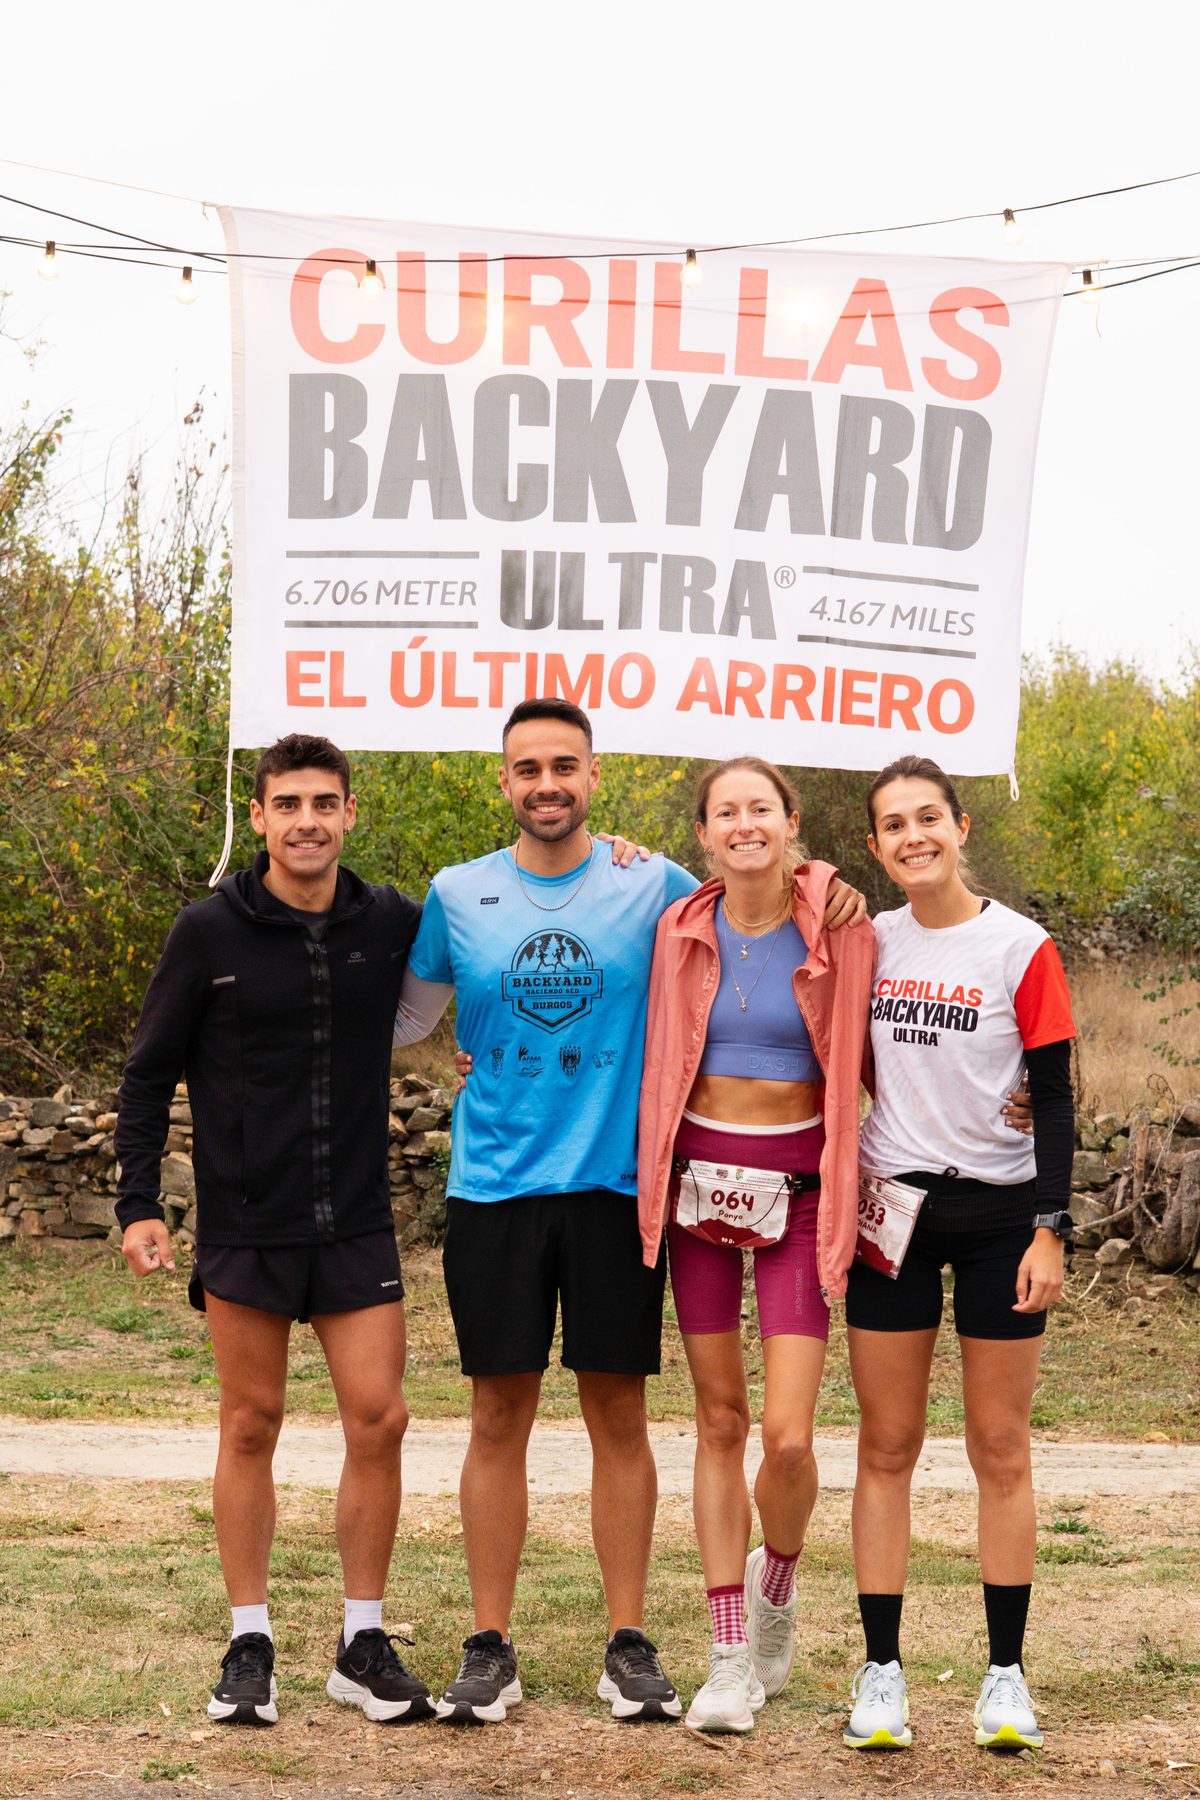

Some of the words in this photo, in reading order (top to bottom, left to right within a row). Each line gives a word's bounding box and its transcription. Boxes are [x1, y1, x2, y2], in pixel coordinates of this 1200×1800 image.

[290, 247, 1010, 401] CURILLAS
[287, 373, 993, 552] BACKYARD
[285, 579, 368, 606] 6.706
[375, 580, 478, 607] METER
[809, 595, 886, 627] 4.167
[889, 603, 977, 637] MILES
[285, 650, 368, 708] EL
[389, 635, 657, 710] ÚLTIMO
[675, 656, 976, 735] ARRIERO
[512, 976, 593, 988] BACKYARD
[876, 978, 984, 1008] CURILLAS
[532, 1001, 573, 1010] BURGOS
[873, 997, 980, 1033] BACKYARD
[747, 1053, 801, 1074] DASH
[710, 1189, 755, 1212] 064
[857, 1198, 886, 1226] 053
[718, 1209, 743, 1222] Ponyo
